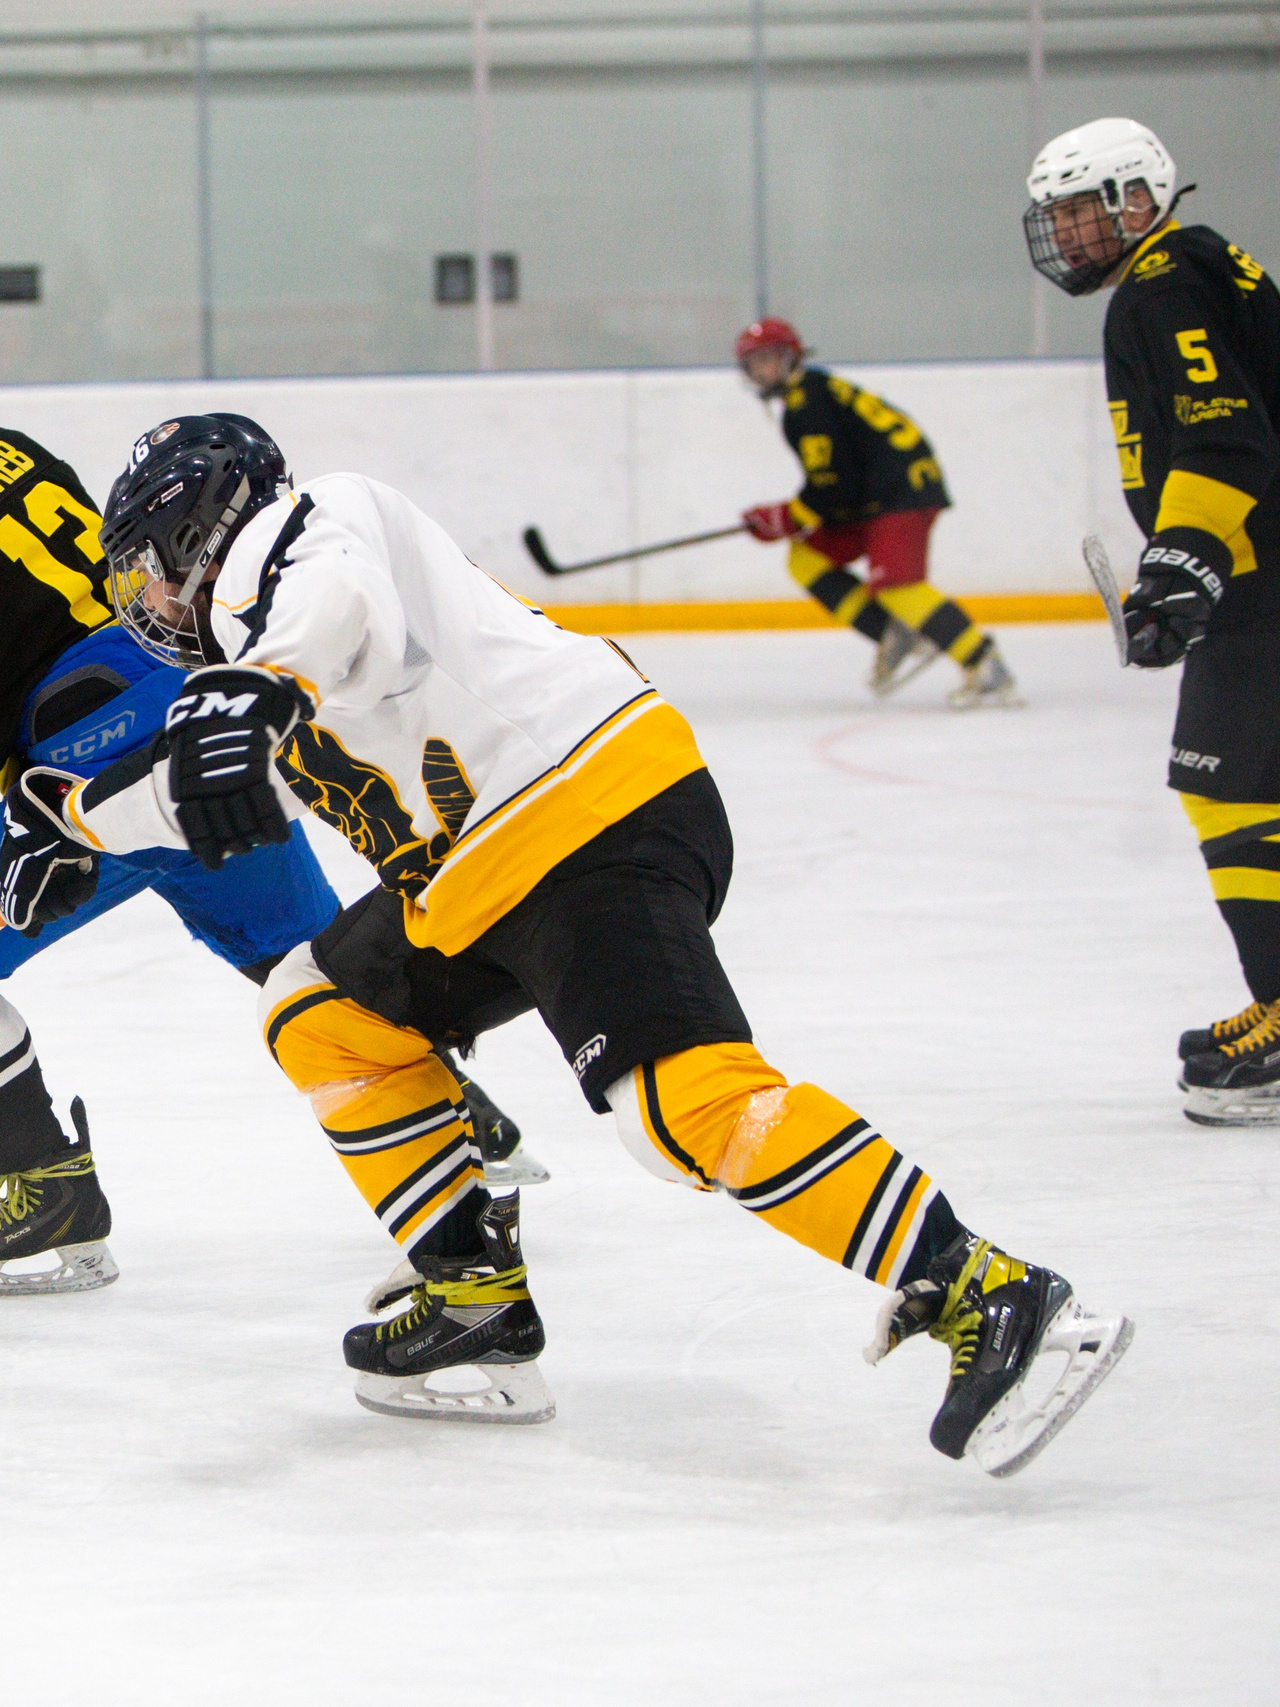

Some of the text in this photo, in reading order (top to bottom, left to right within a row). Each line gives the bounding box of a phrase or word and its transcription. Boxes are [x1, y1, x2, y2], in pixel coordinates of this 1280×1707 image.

[1175, 328, 1218, 383] 5
[50, 722, 126, 764] CCM
[4, 1225, 31, 1244] TACKS
